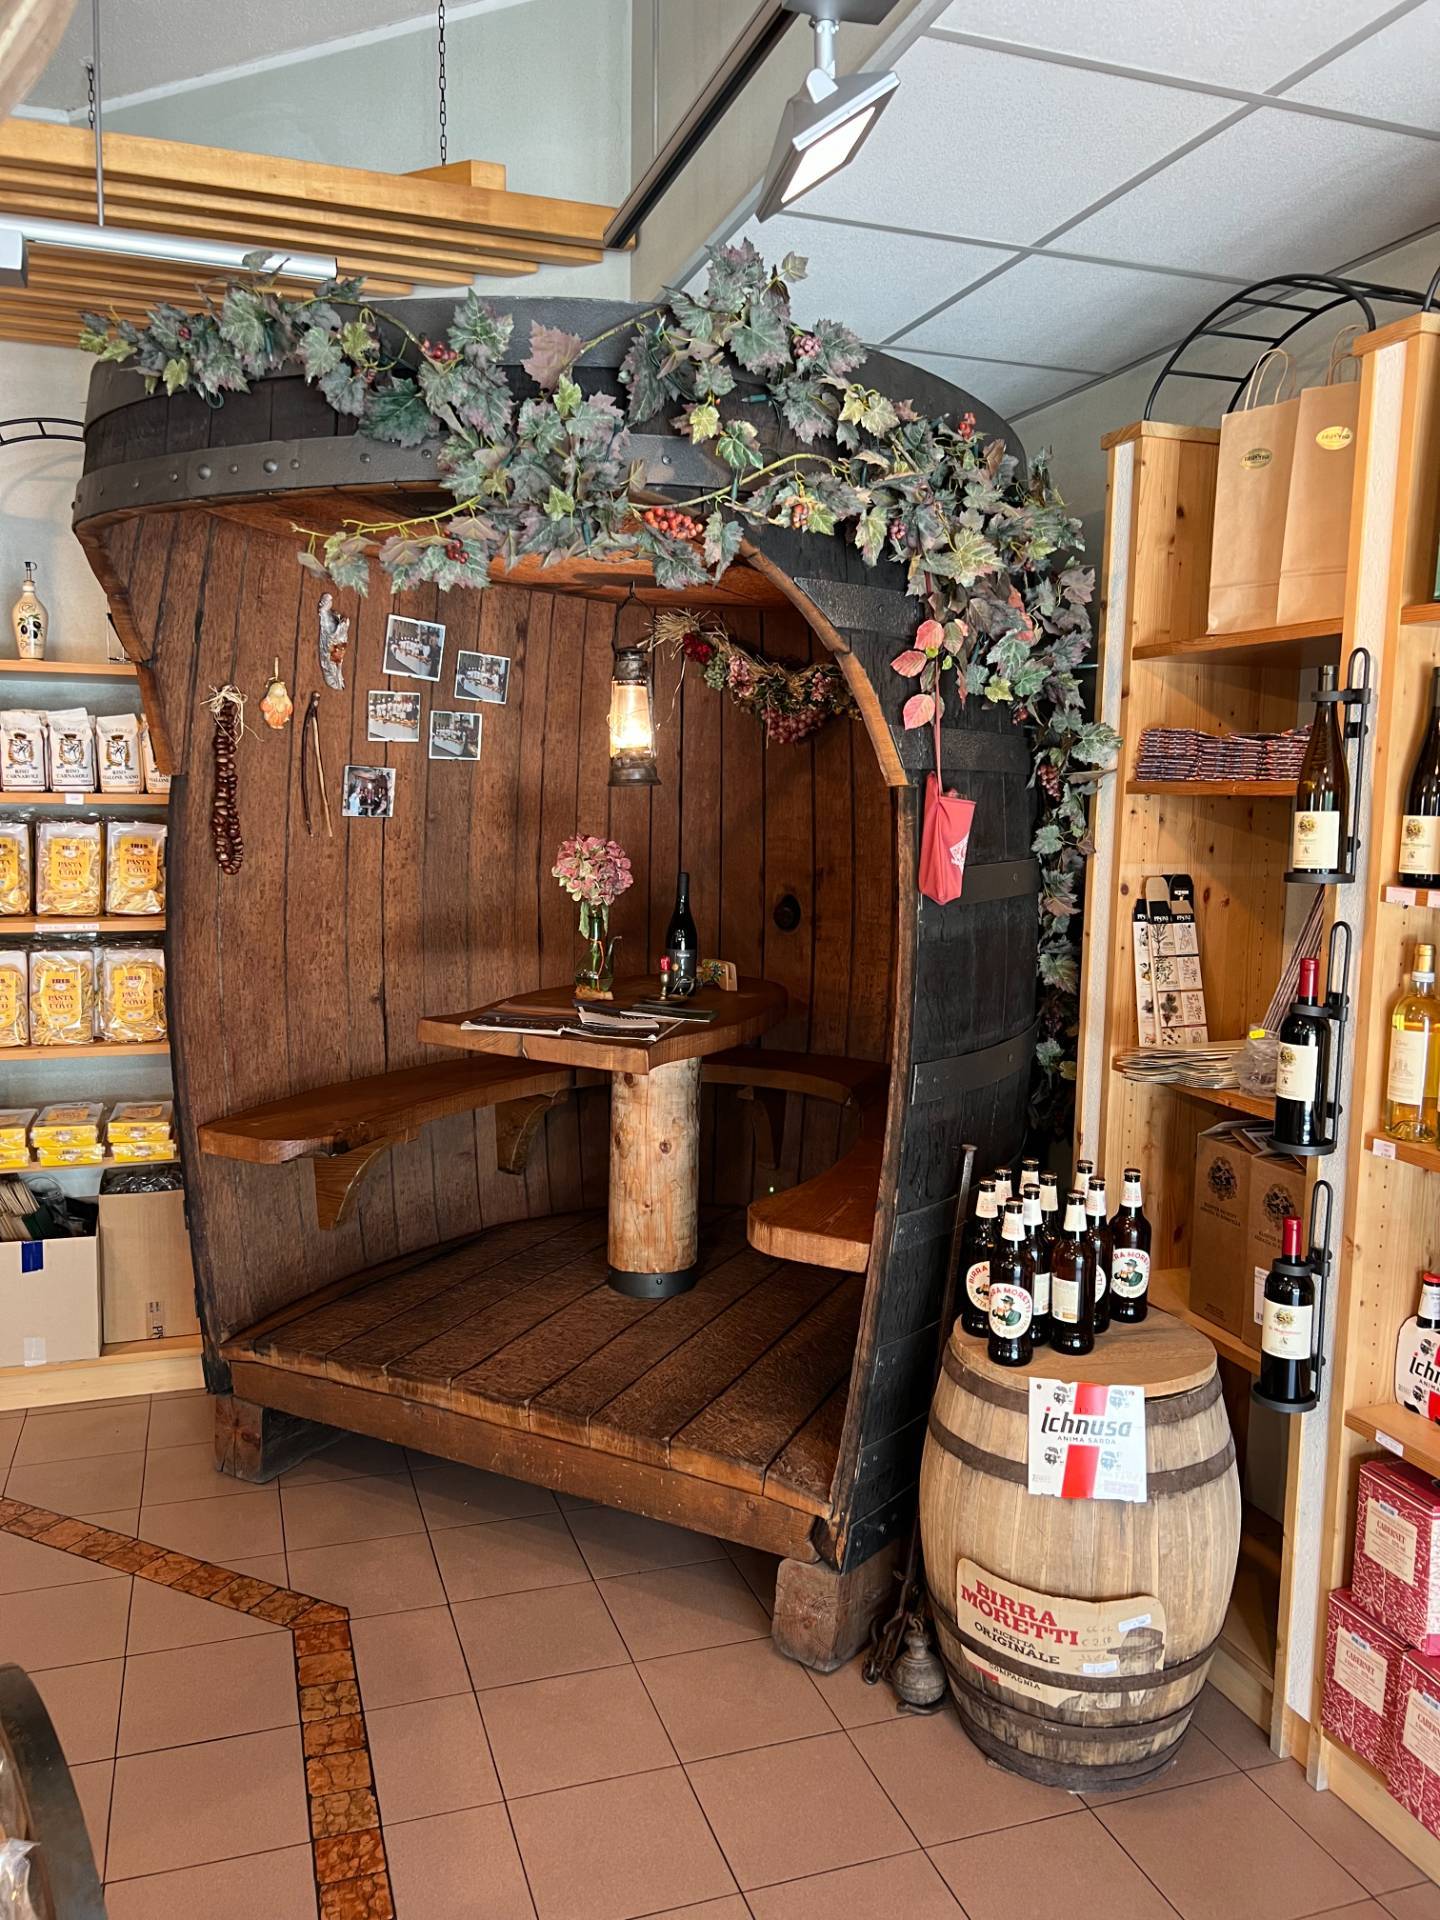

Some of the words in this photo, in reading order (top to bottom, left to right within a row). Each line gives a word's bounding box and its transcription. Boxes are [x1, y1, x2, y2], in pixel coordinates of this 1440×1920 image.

[126, 858, 151, 866] PASTA
[968, 1265, 989, 1284] BIRRA
[1041, 1406, 1133, 1437] ichnusa
[1057, 1434, 1085, 1443] ANIMA
[1087, 1437, 1117, 1445] SARDA
[961, 1584, 1079, 1646] MORETTI
[976, 1579, 1057, 1627] BIRRA
[974, 1621, 1060, 1665] ORIGINALE
[993, 1626, 1036, 1649] RICETTA
